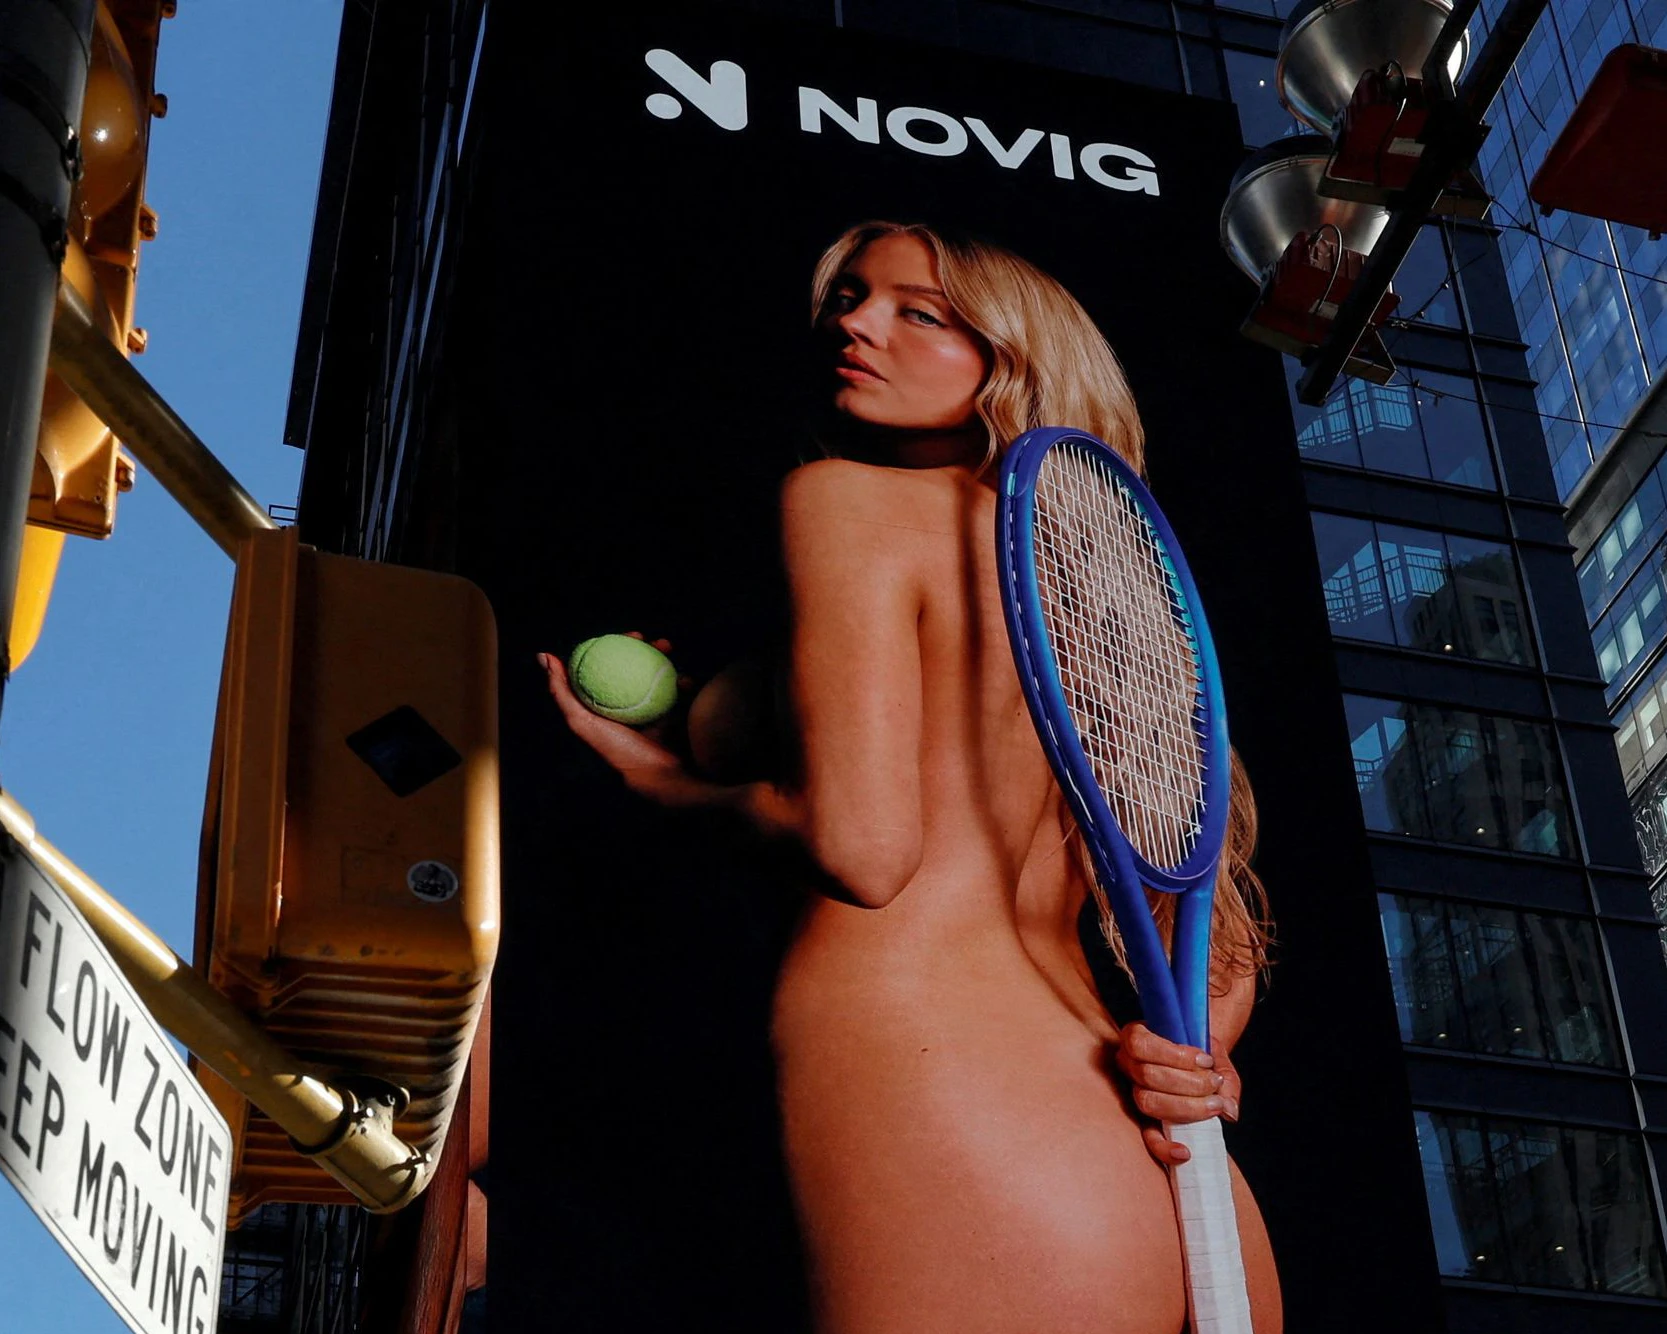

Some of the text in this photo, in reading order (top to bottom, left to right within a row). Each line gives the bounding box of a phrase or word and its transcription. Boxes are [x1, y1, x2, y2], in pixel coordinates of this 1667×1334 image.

[798, 86, 1160, 196] NOVIG
[19, 890, 223, 1236] FLOW ZONE
